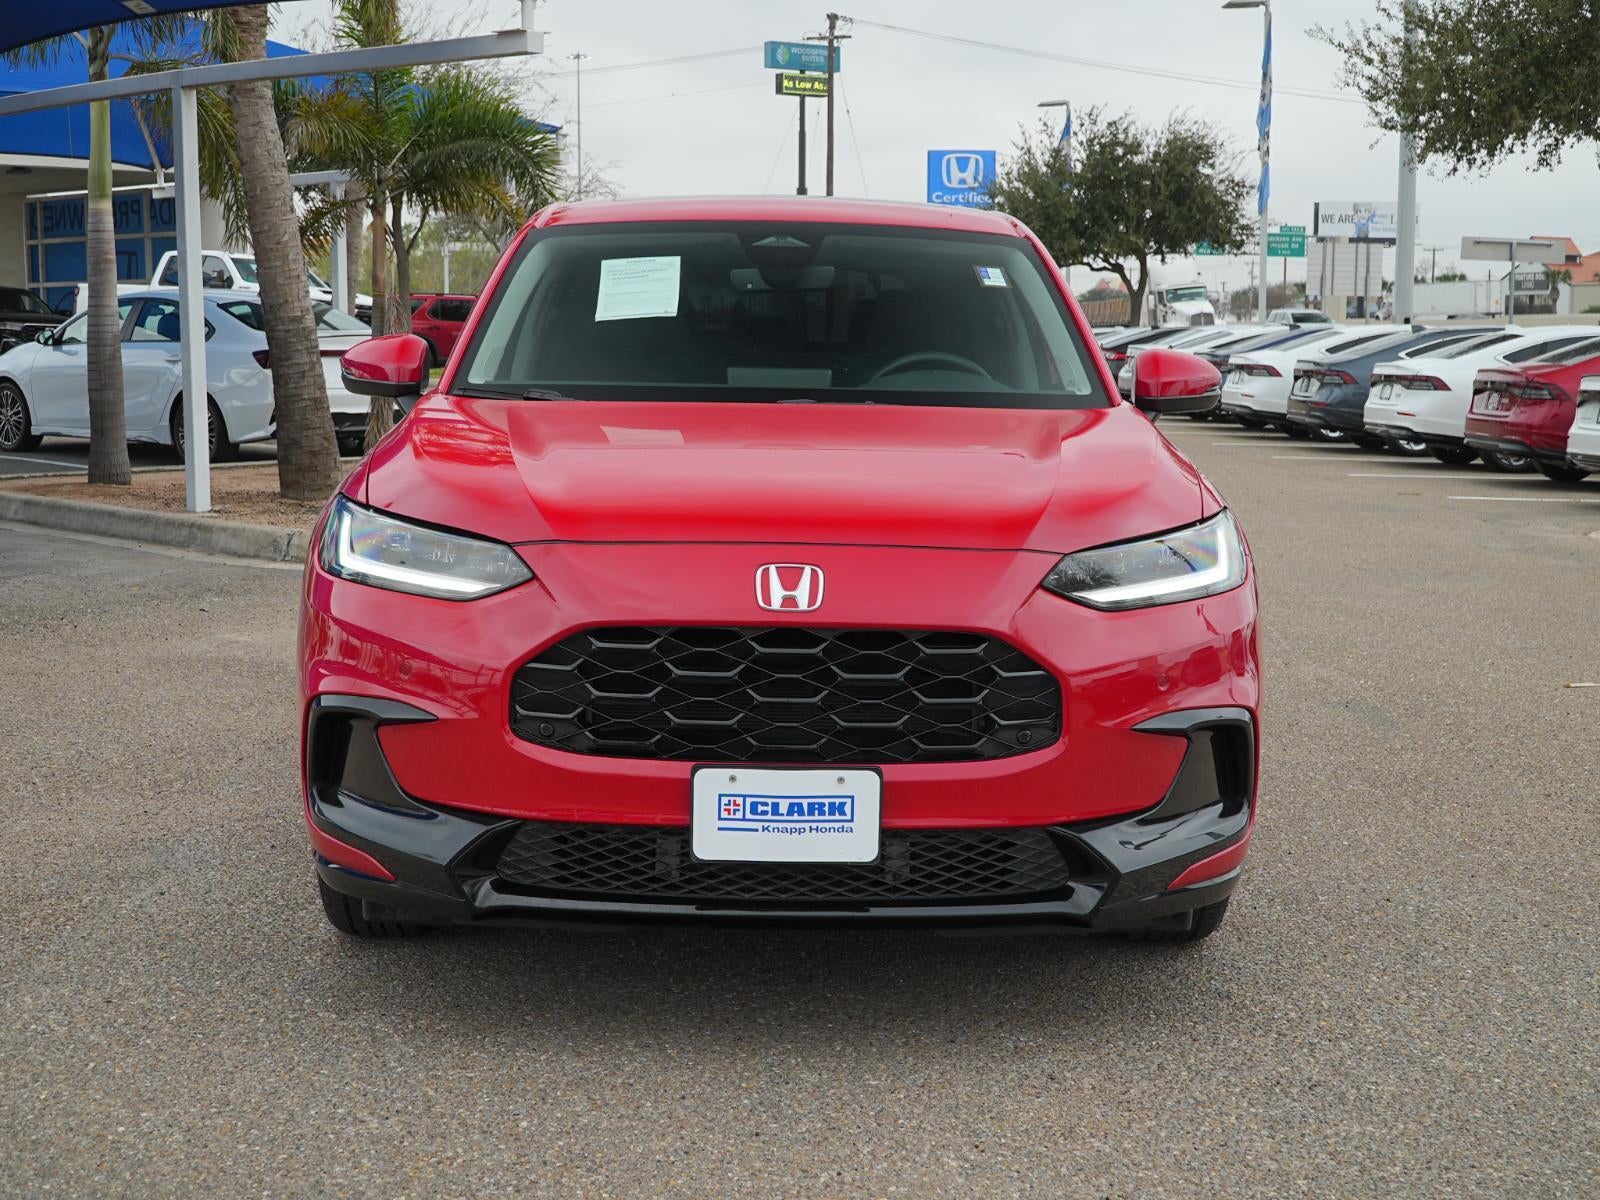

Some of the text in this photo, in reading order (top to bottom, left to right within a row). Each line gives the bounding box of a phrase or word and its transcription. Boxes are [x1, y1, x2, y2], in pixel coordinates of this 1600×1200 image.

[784, 79, 793, 88] As
[795, 80, 812, 89] Low
[1321, 213, 1356, 224] WE ARE
[749, 800, 848, 817] CLARK
[761, 824, 854, 836] Knapp Honda
